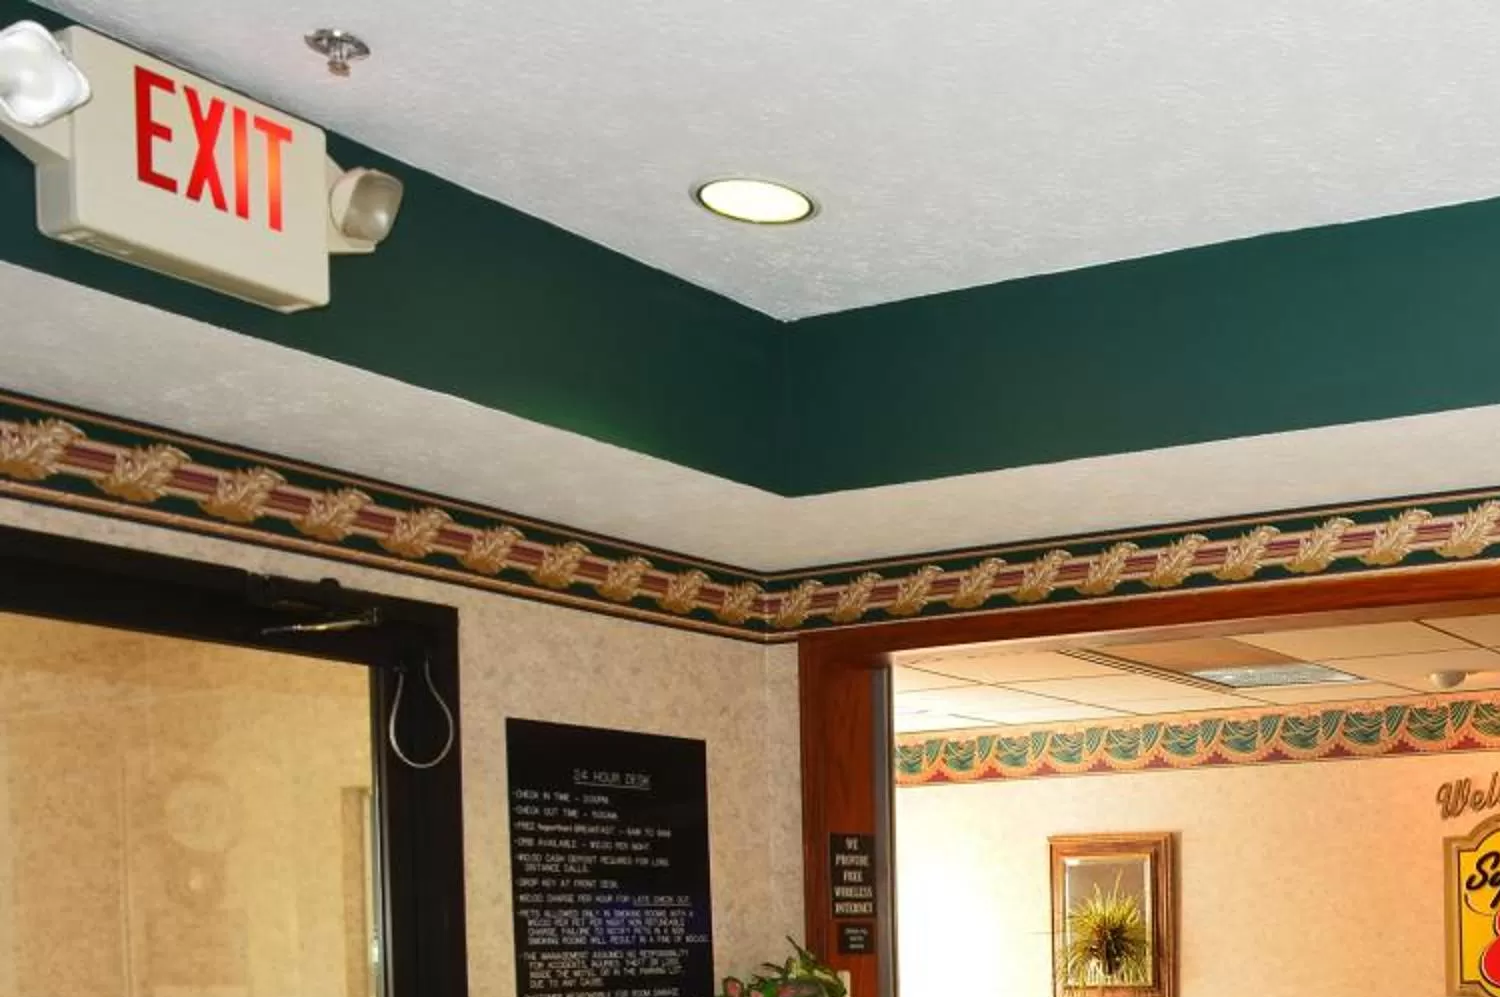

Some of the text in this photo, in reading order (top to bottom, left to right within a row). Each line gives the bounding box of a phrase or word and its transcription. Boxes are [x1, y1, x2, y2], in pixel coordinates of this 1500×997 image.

[134, 65, 293, 233] EXIT
[845, 837, 859, 850] WE
[835, 854, 869, 866] PROVIDE
[843, 870, 862, 883] FREE
[834, 886, 873, 898] WIRELESS
[835, 902, 873, 915] INTERNET
